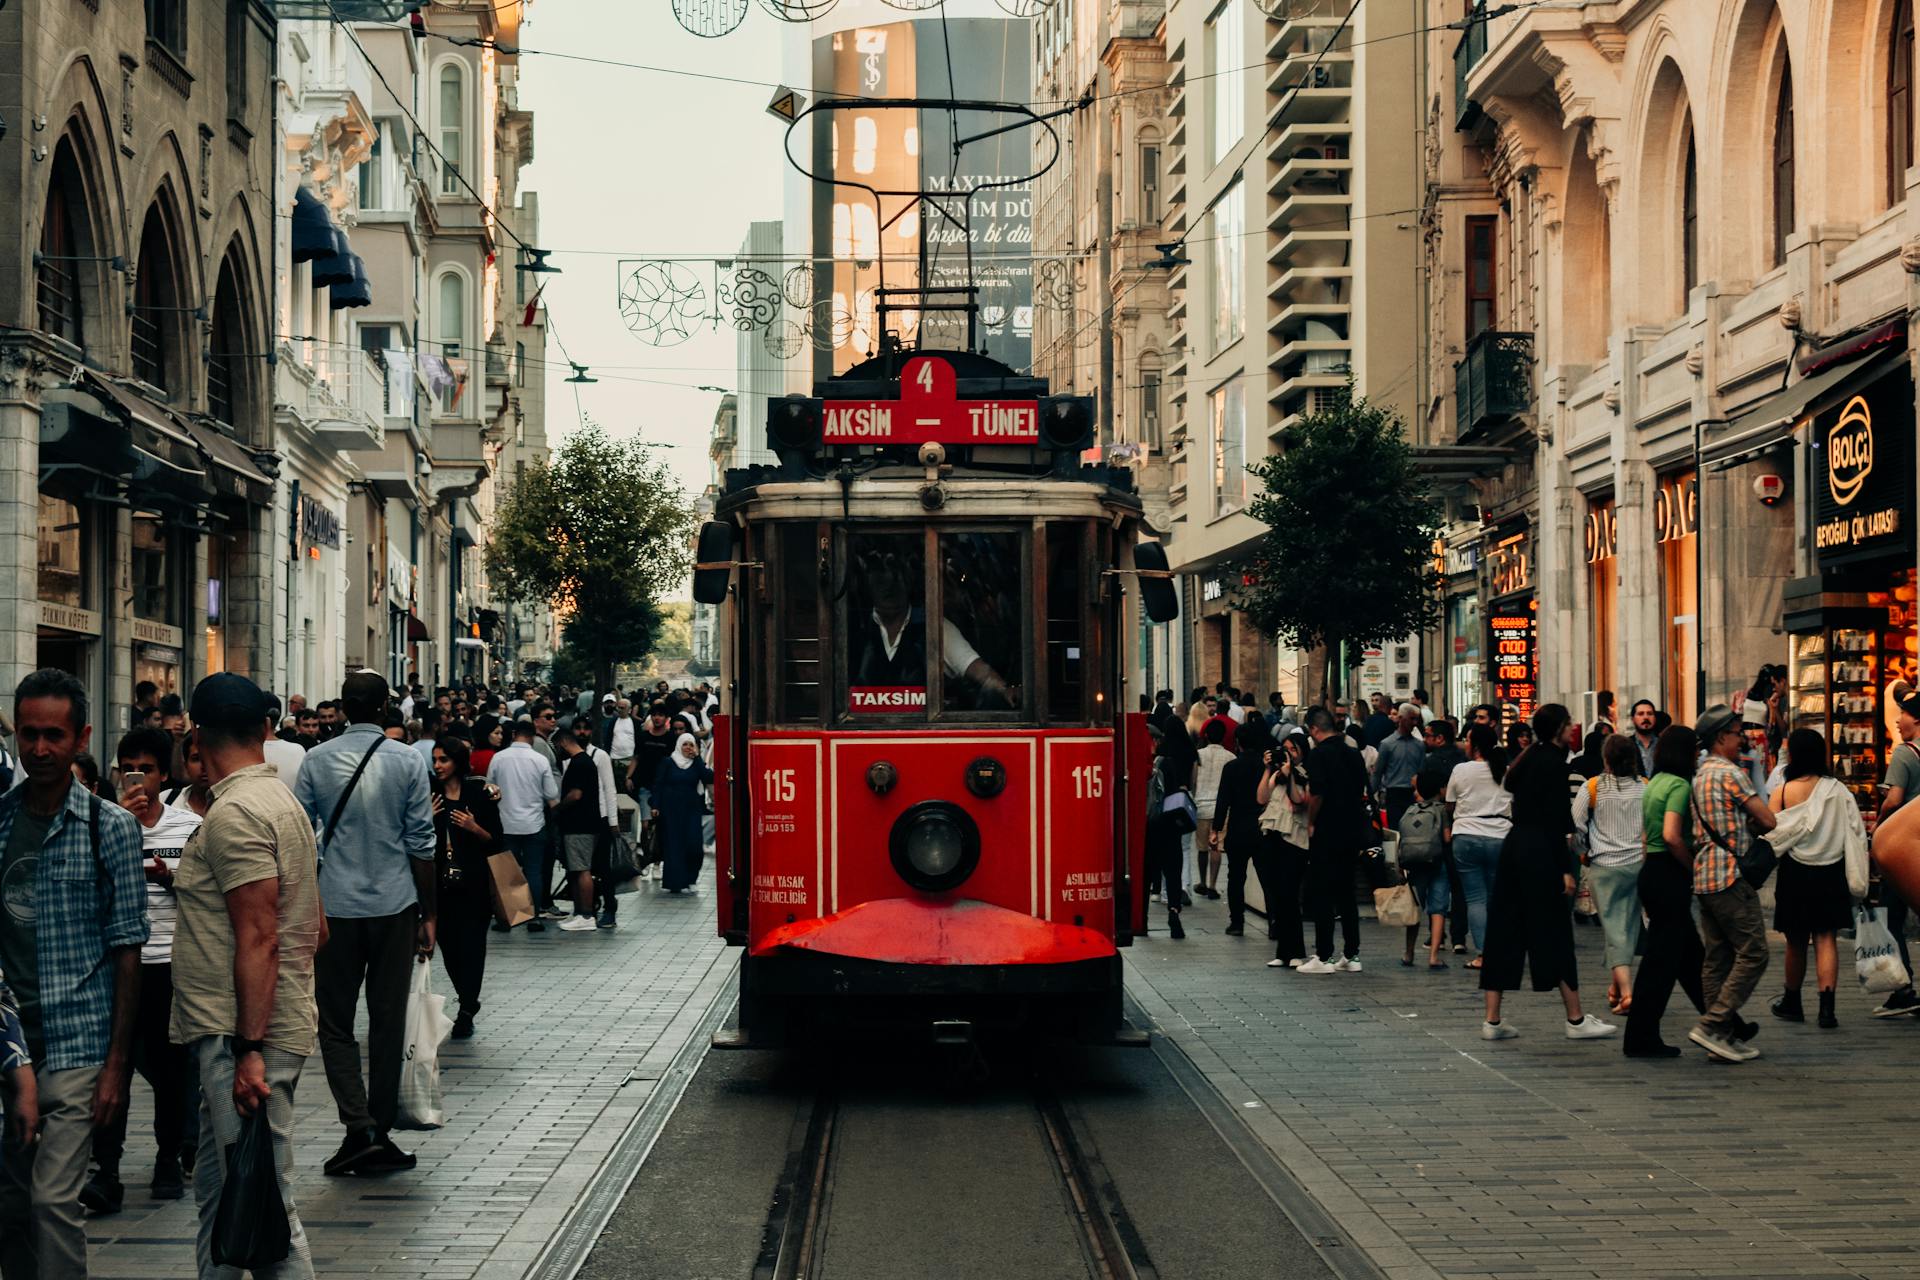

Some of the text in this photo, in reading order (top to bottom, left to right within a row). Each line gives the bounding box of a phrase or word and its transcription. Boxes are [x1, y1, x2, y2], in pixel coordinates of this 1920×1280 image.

[928, 198, 998, 218] BENİM
[927, 223, 979, 246] başka
[916, 361, 933, 393] 4
[822, 404, 892, 436] AKSİM
[968, 404, 1039, 436] TÜNEL
[68, 609, 89, 630] KÖFTE
[154, 624, 172, 643] KÖFTE
[852, 690, 926, 706] TAKSİM
[764, 769, 795, 801] 115
[1071, 766, 1103, 799] 115
[780, 824, 795, 832] 153
[153, 849, 181, 857] GUESS
[777, 876, 805, 888] YASAK
[1062, 889, 1074, 902] VE
